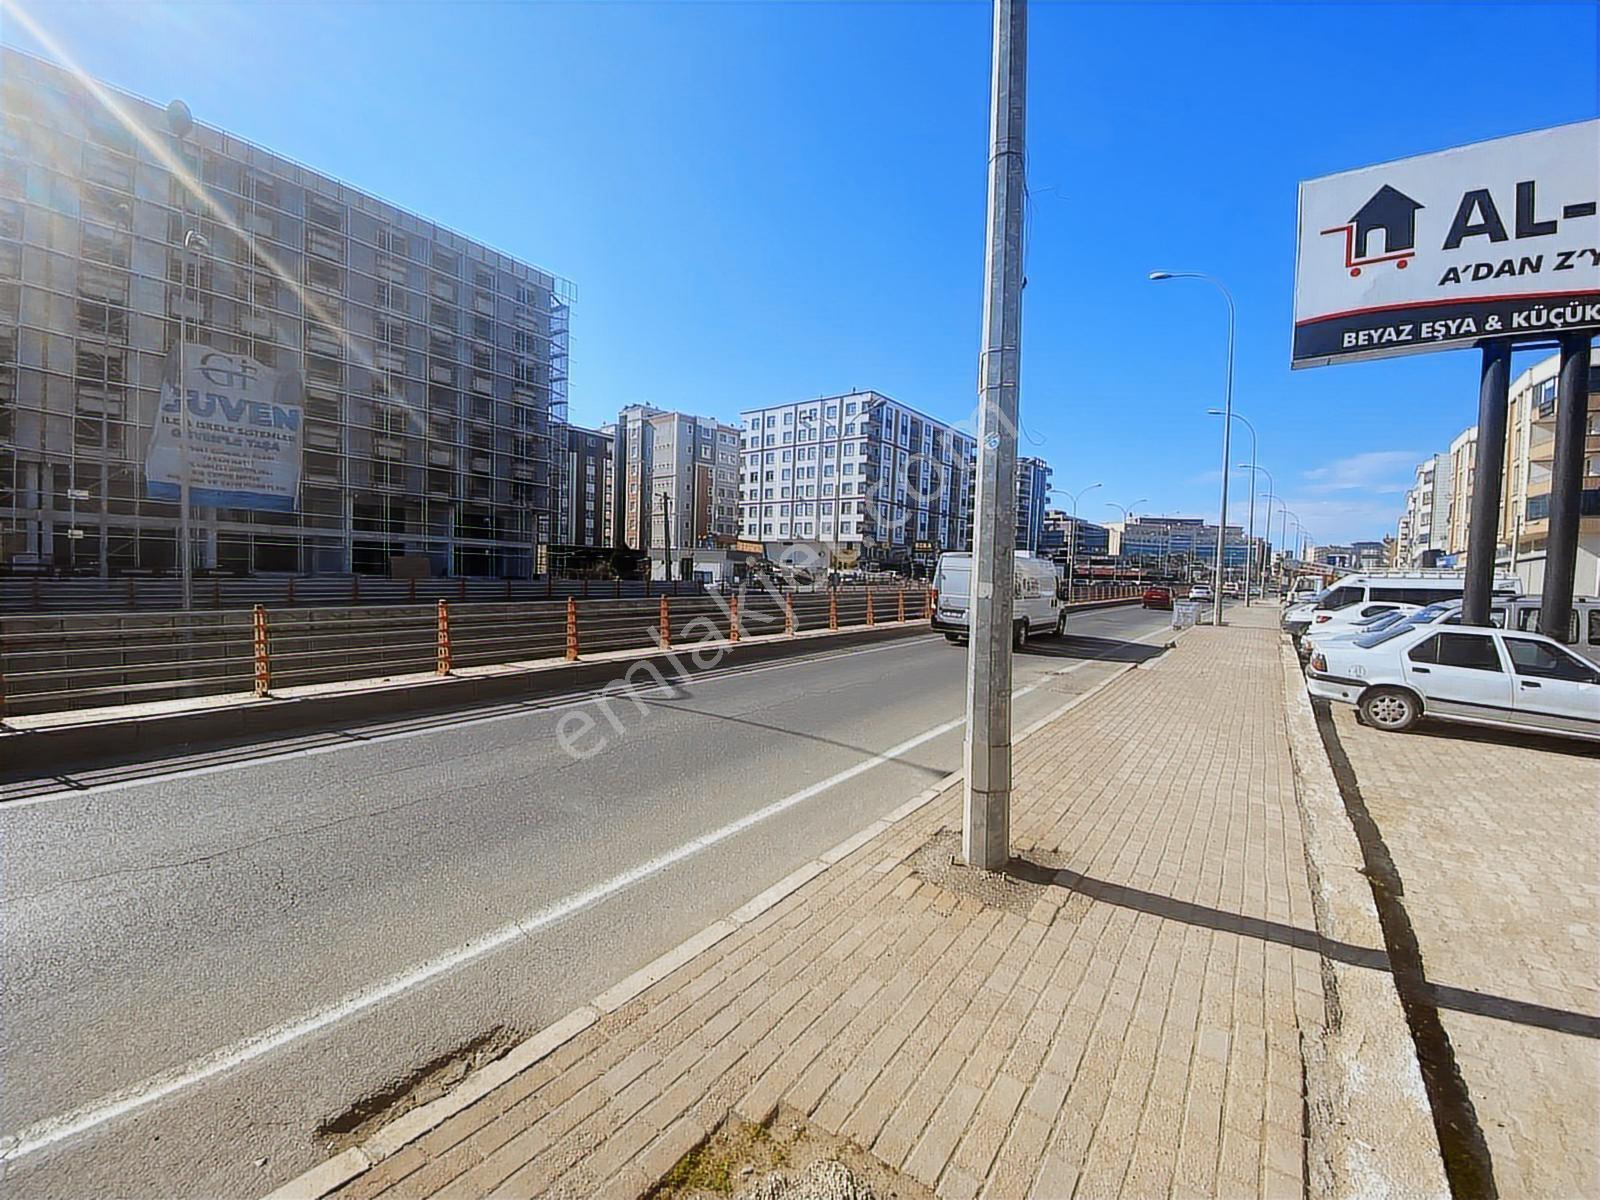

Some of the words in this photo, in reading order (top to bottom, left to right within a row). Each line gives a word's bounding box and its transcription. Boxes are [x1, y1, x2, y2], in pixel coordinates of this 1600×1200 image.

[1442, 180, 1597, 251] AL-
[1438, 254, 1544, 286] A'DAN
[1343, 324, 1413, 348] BEYAZ
[1421, 317, 1477, 341] EŞYA
[1485, 315, 1503, 331] &
[1512, 301, 1600, 329] KÜÇÜK
